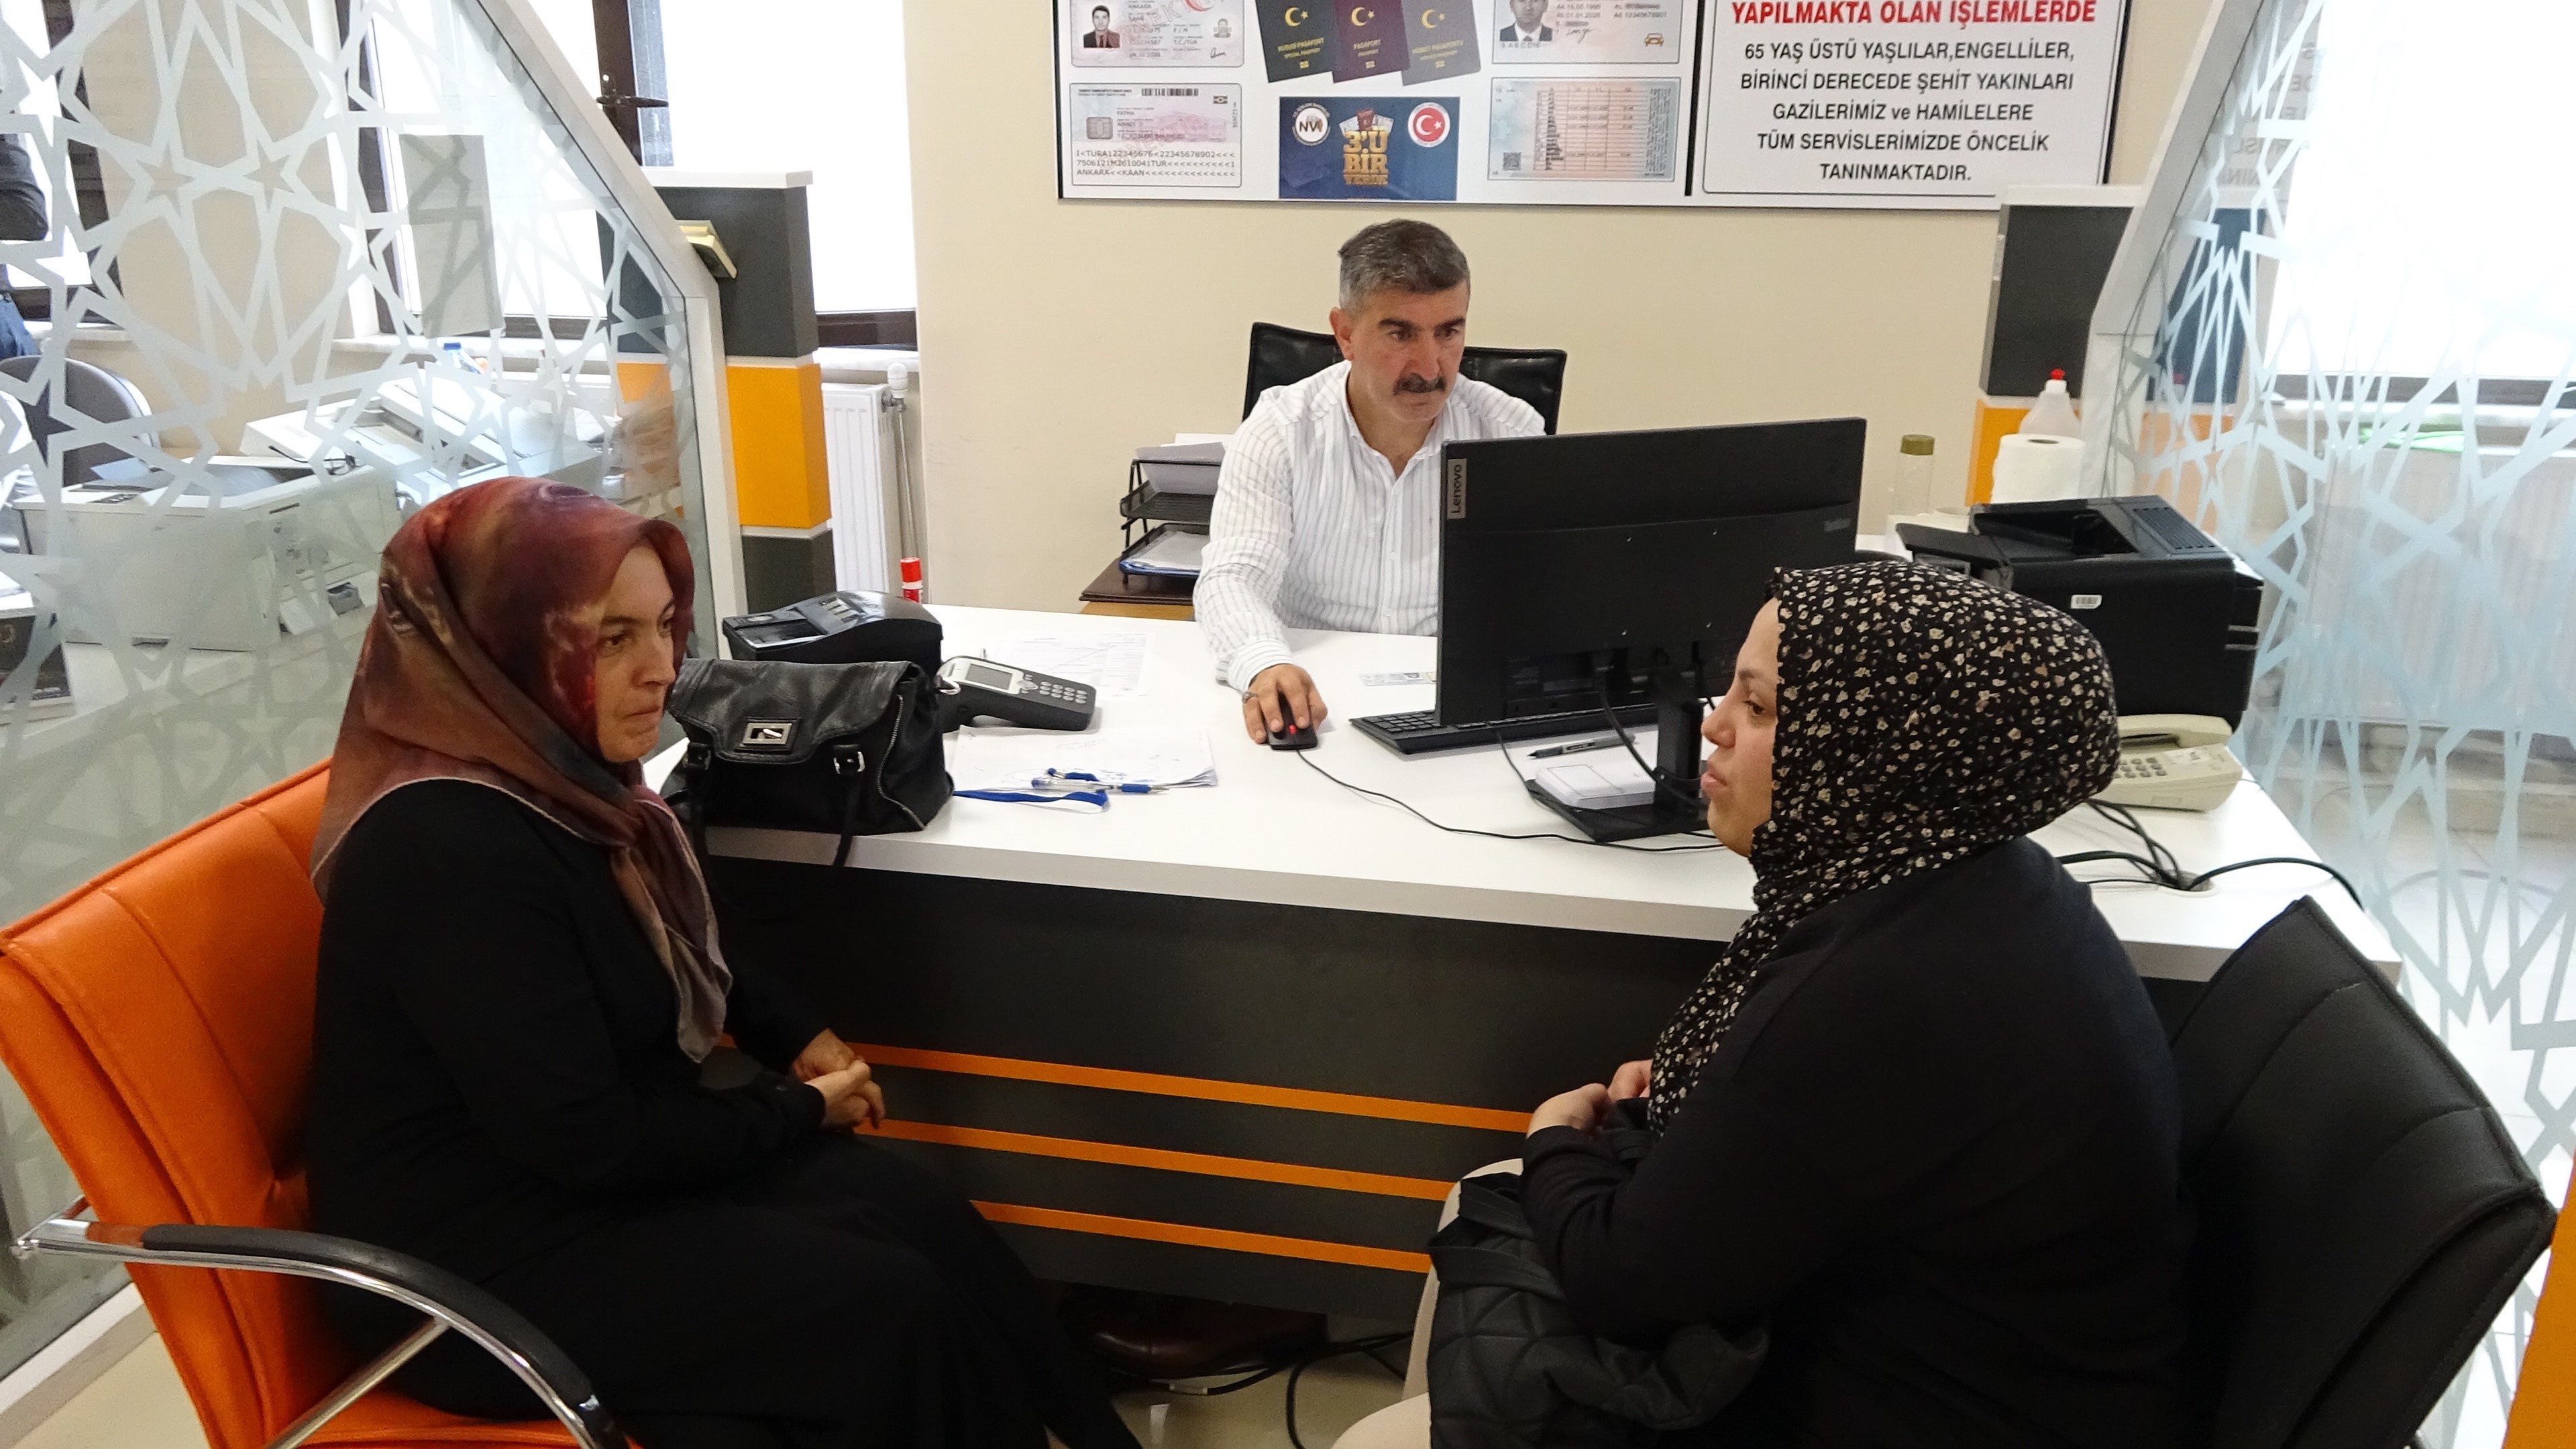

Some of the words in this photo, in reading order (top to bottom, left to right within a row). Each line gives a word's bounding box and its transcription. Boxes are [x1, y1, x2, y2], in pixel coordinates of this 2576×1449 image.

[1731, 1, 1872, 23] YAPILMAKTA
[1880, 1, 1941, 23] OLAN
[1746, 43, 1764, 60] 65
[1770, 43, 1803, 64] YAŞ
[1810, 38, 1856, 59] ÜSTÜ
[1741, 68, 1807, 89] BİRİNCİ
[1813, 73, 1911, 89] DERECEDE
[1917, 69, 1971, 94] ŞEHİT
[1977, 73, 2074, 90] YAKINLARI
[1773, 99, 1886, 120] GAZİLERİMİZ
[1892, 108, 1910, 120] ve
[1917, 100, 2034, 121] HAMİLELERE
[1758, 129, 1794, 150] TÜM
[1801, 129, 1962, 150] SERVİSLERİMİZDE
[1967, 131, 2049, 151] ÖNCELİK
[1820, 164, 1971, 180] TANINMAKTADIR.
[1451, 464, 1462, 514] Lenovo
